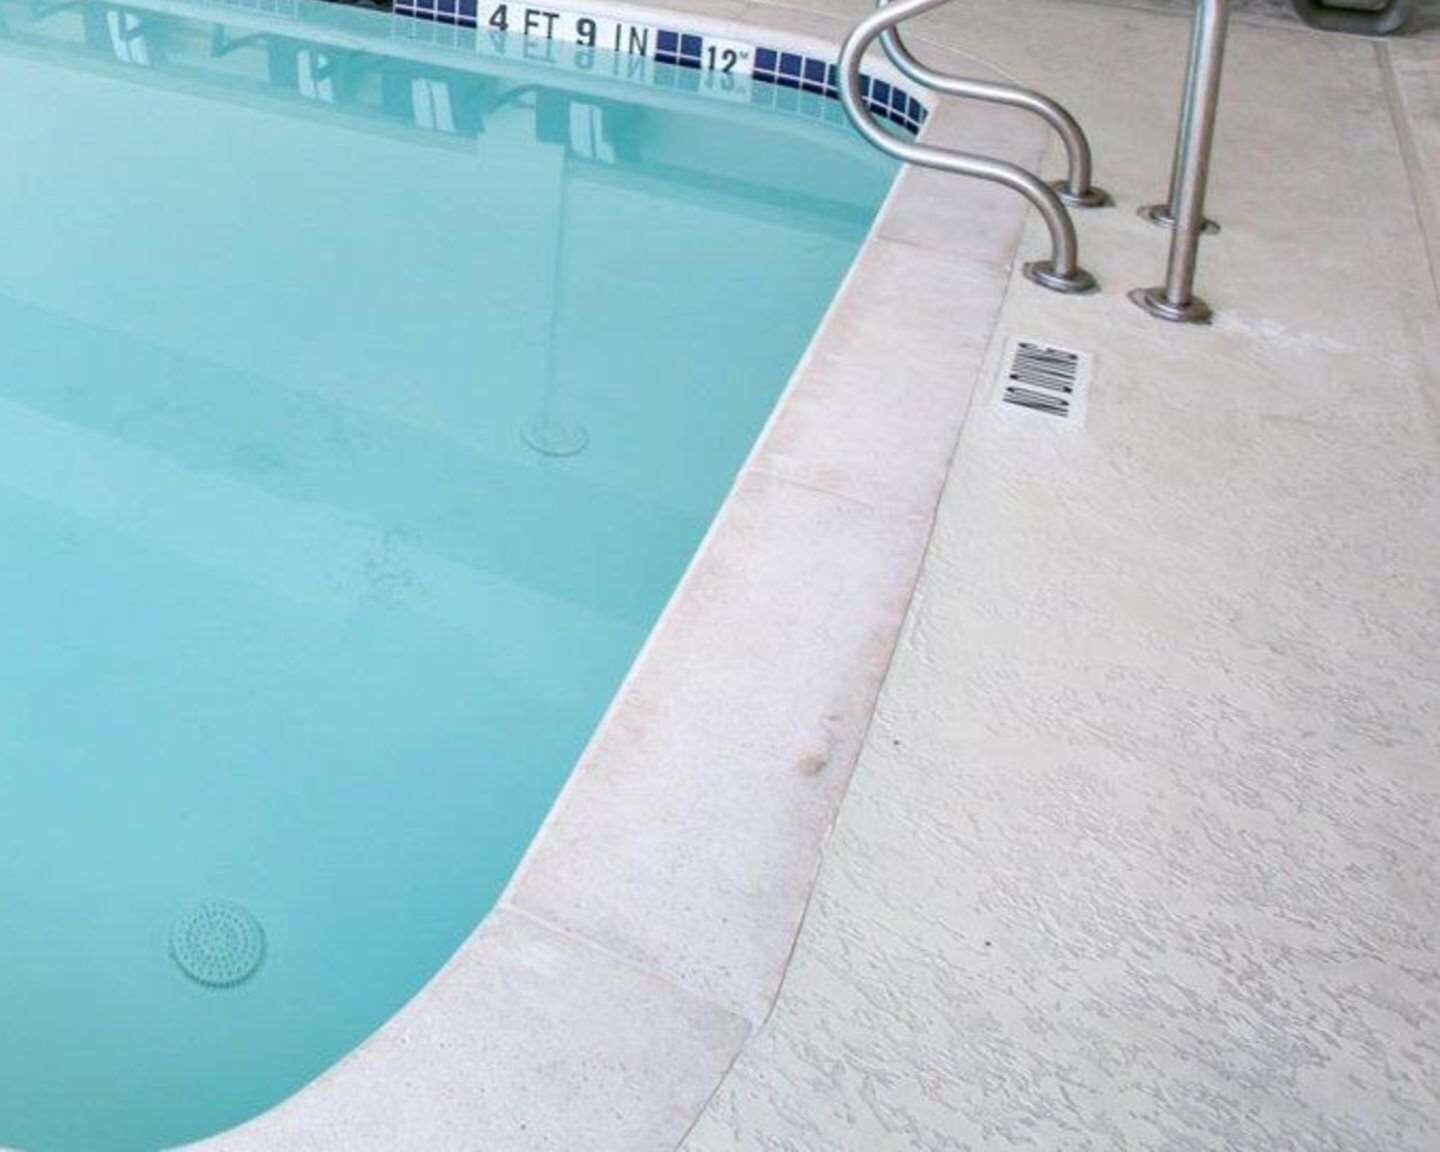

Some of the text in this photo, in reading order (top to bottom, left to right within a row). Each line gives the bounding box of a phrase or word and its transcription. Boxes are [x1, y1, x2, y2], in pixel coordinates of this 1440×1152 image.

[488, 4, 649, 57] 4 FT 9 IN
